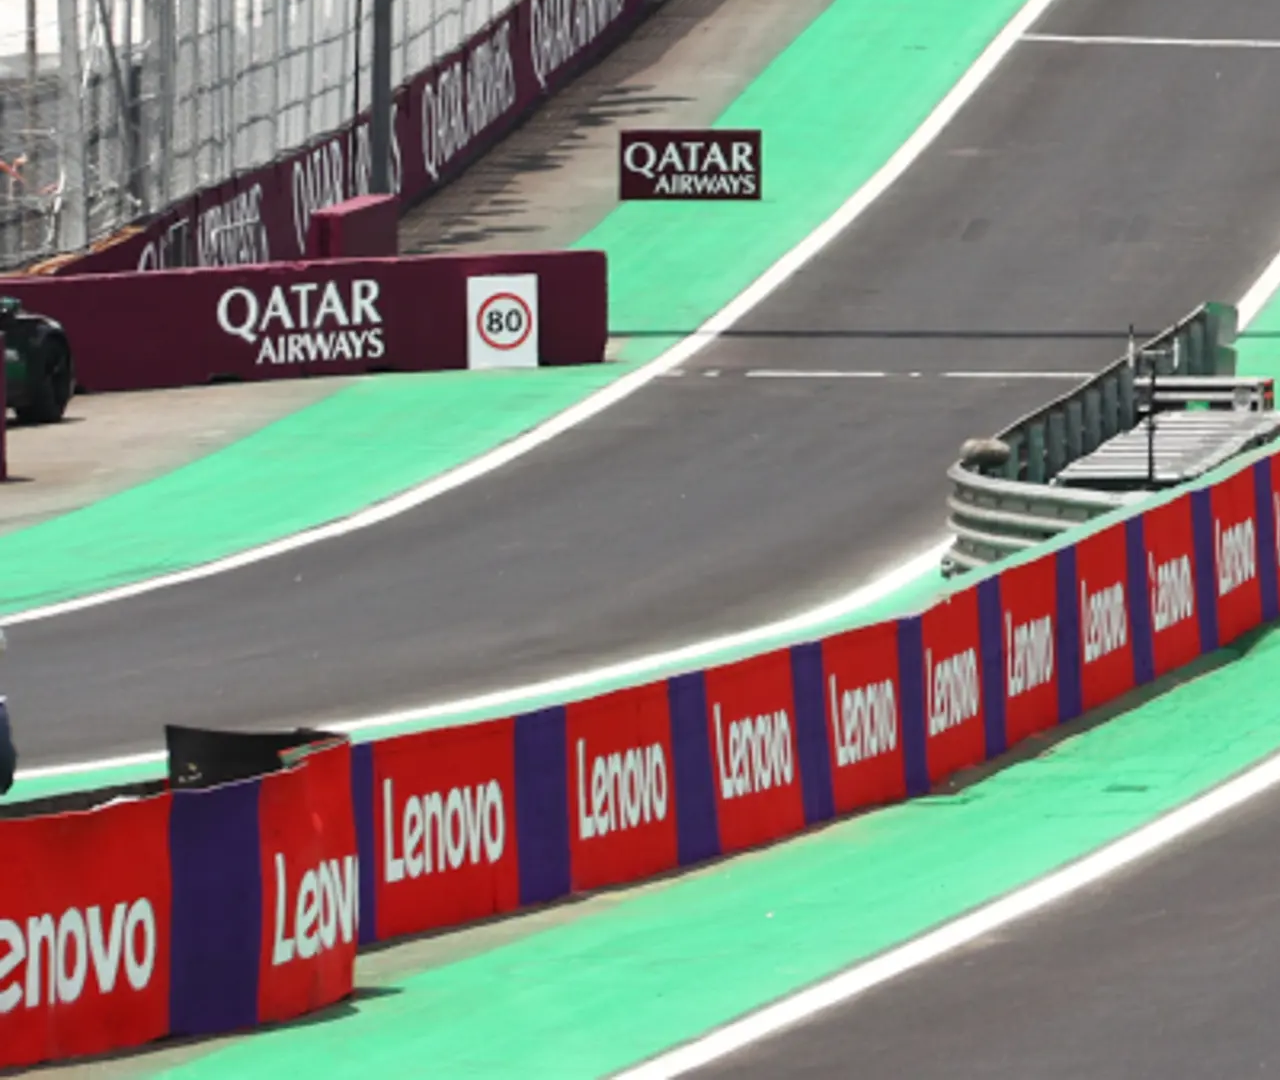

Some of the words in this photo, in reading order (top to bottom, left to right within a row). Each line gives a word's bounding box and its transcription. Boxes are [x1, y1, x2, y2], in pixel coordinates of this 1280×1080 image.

[623, 141, 755, 179] QATAR
[653, 174, 756, 195] AIRWAYS
[216, 278, 383, 344] QATAR
[256, 329, 385, 365] AIRWAYS
[486, 310, 524, 334] 80
[1215, 517, 1255, 597] Lenovo
[1005, 612, 1055, 698] Lenovo
[1081, 579, 1128, 663] Lenovo
[829, 674, 897, 767] Lenovo
[926, 648, 979, 737] Lenovo
[577, 737, 668, 841] Lenovo
[714, 703, 794, 799] Lenovo
[383, 777, 505, 884] Lenovo
[0, 897, 156, 1013] enovo
